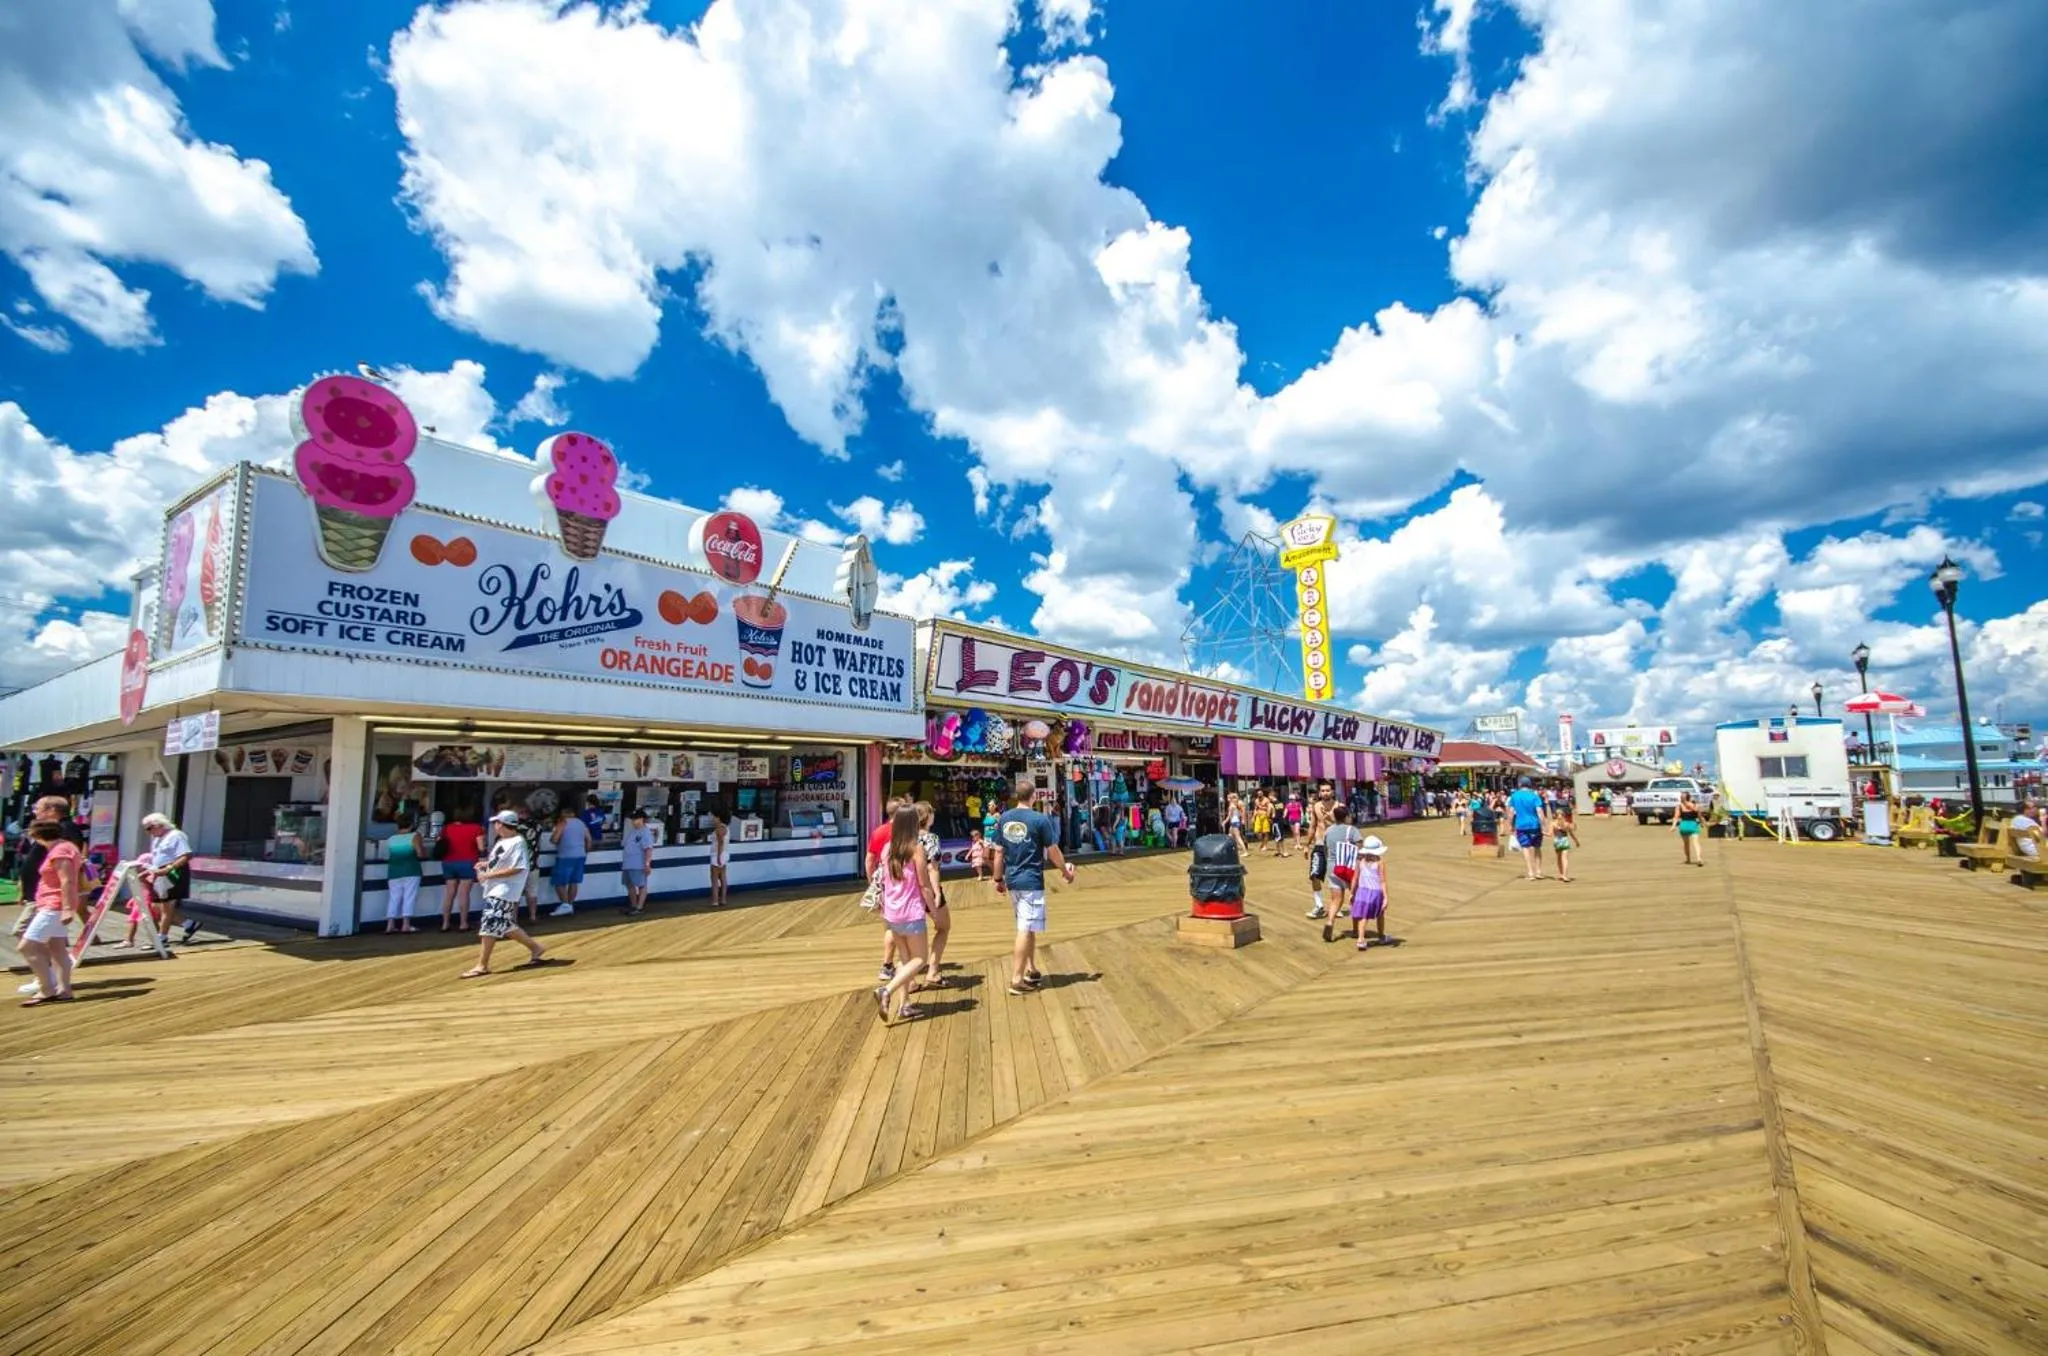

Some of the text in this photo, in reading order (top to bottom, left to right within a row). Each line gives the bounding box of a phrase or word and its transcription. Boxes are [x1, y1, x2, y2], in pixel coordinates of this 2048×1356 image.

[1285, 546, 1333, 562] Amusement
[328, 581, 420, 607] FROZEN
[470, 563, 630, 636] Kohr's
[317, 600, 426, 626] CUSTARD
[265, 615, 466, 653] SOFT ICE CREAM
[538, 622, 617, 643] THE ORIGINAL
[634, 636, 708, 657] Fresh Fruit
[816, 628, 884, 650] HOMEMADE
[601, 648, 735, 683] ORANGEADE
[791, 640, 905, 678] HOT WAFFLES
[956, 636, 1117, 705] LEO'S
[794, 668, 902, 702] & ICE CREAM
[1250, 697, 1315, 735] LUCKY
[1369, 721, 1409, 750] LUCKY
[808, 780, 847, 791] CUSTARD
